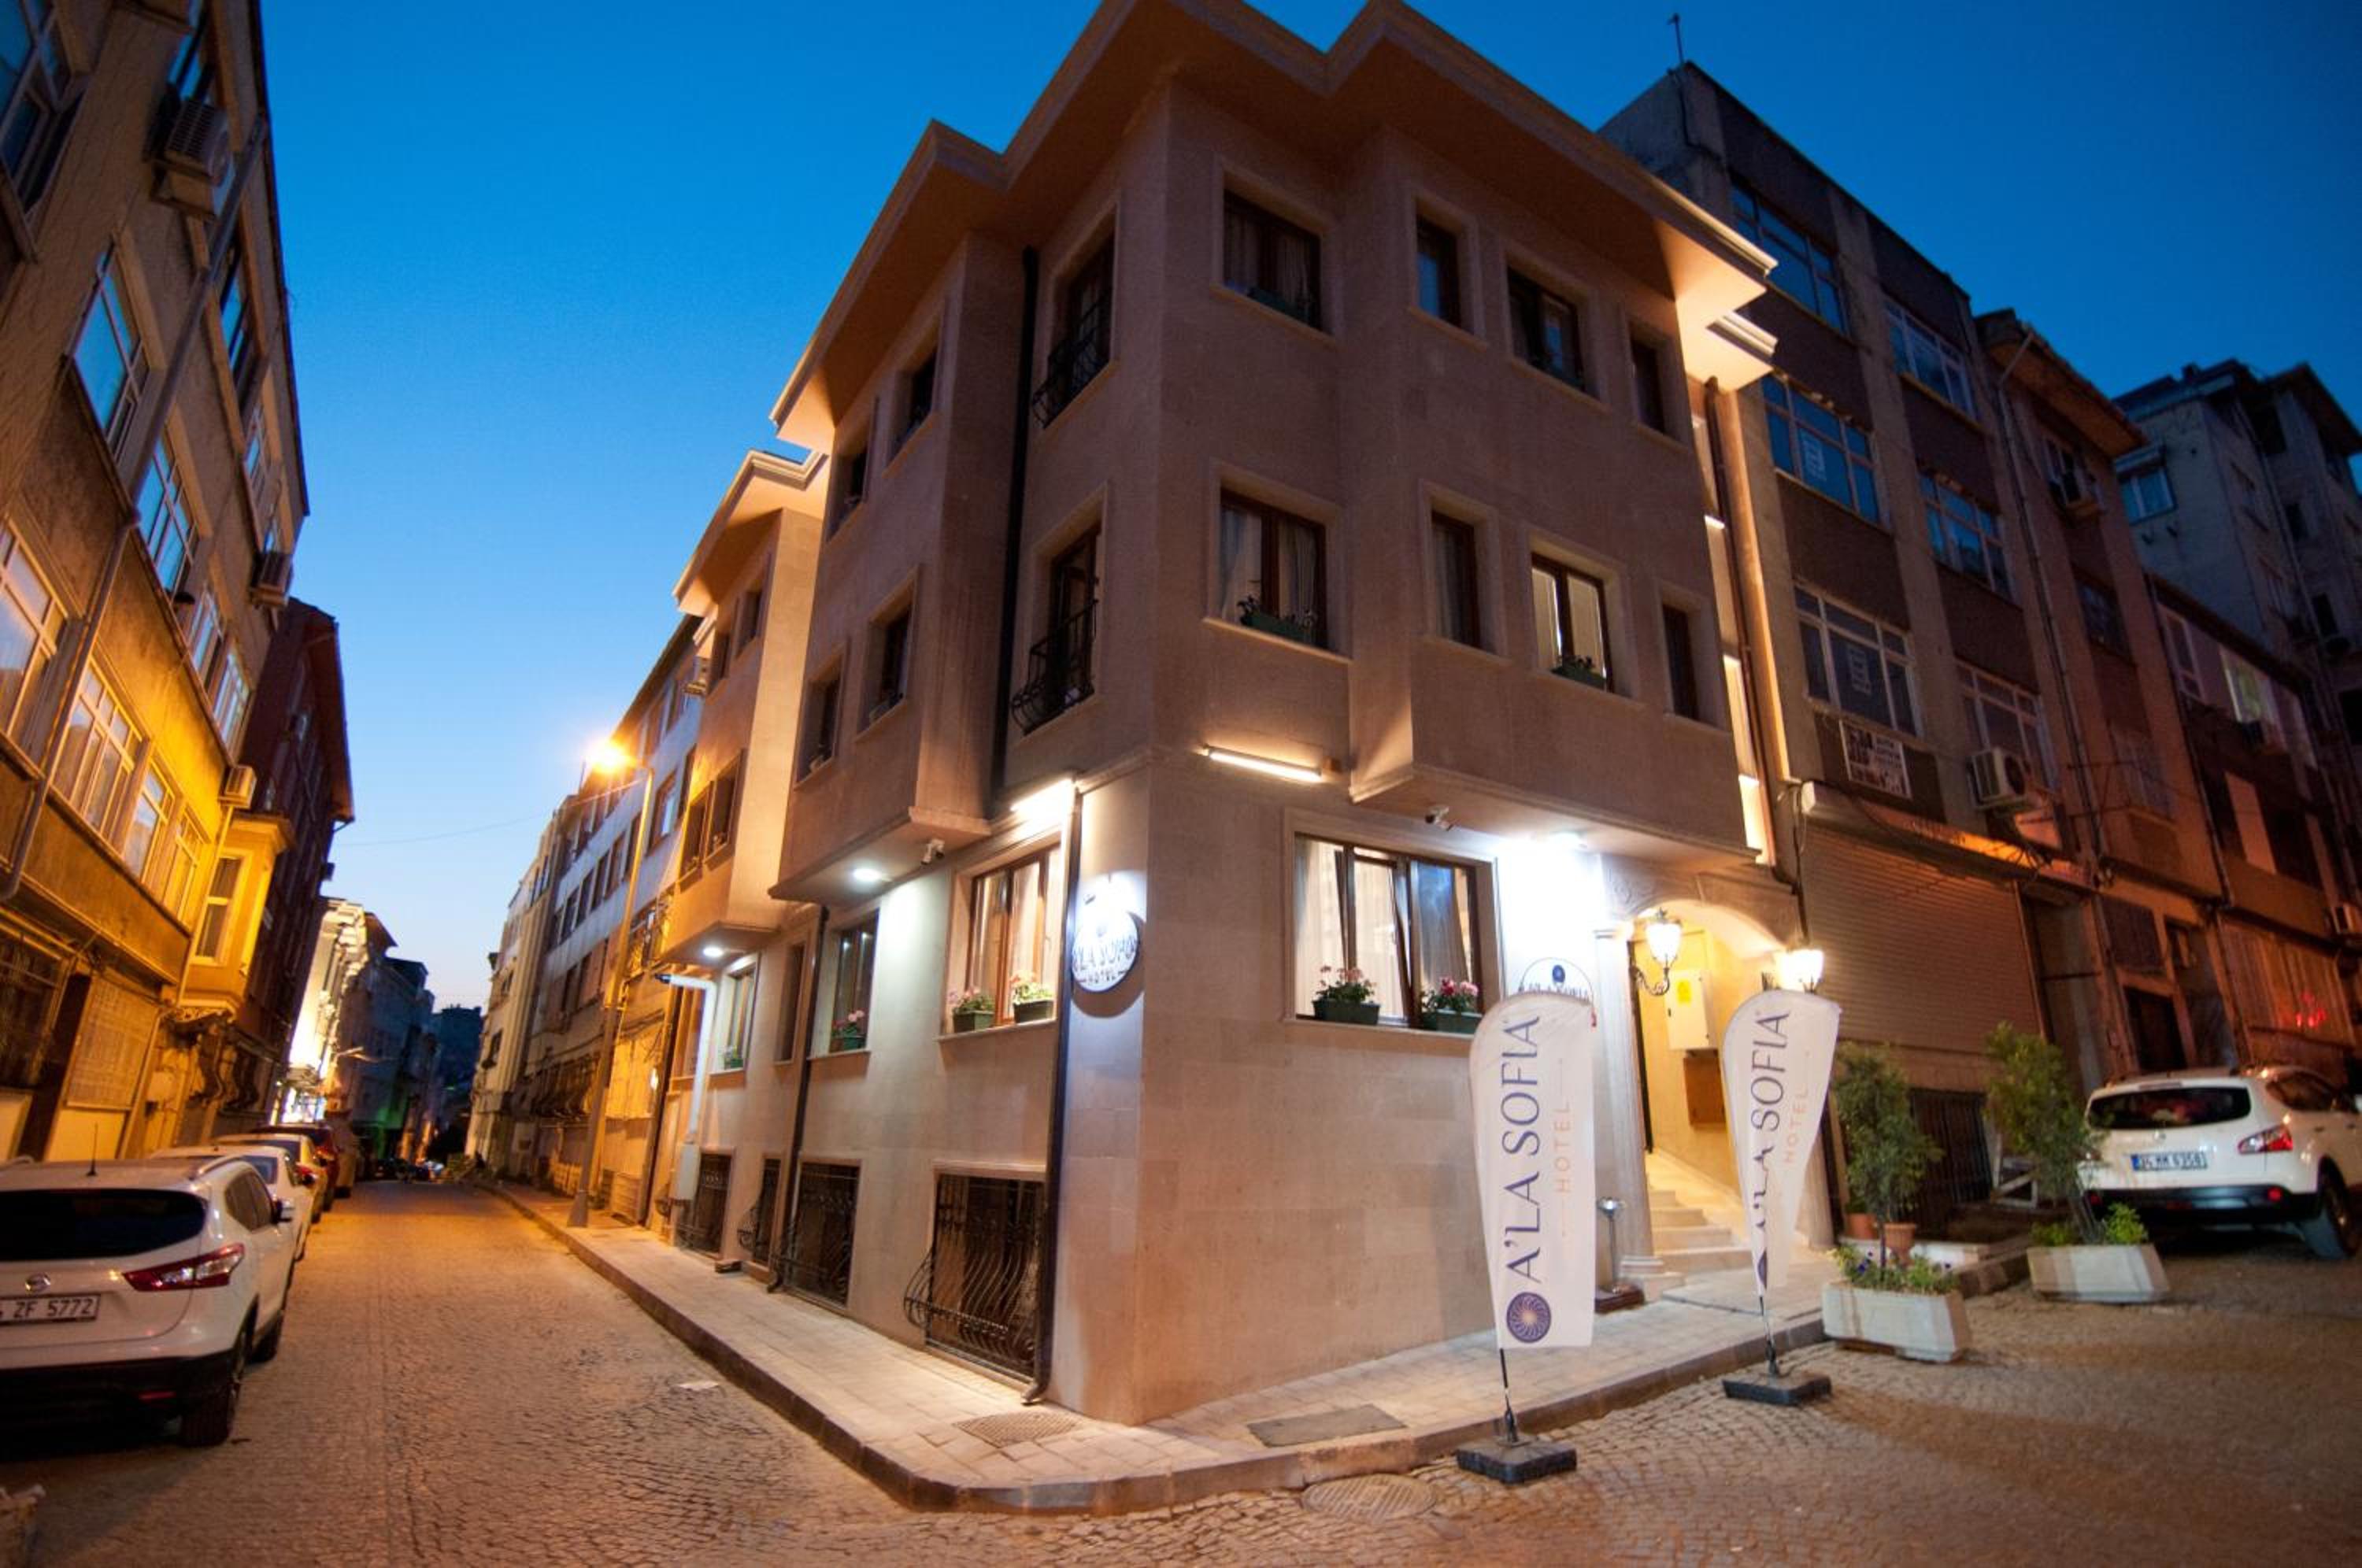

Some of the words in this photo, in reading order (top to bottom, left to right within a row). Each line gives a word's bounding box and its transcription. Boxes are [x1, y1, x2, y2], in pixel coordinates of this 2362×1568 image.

[1500, 1015, 1541, 1156] SOFIA
[1750, 1011, 1791, 1132] SOFIA
[1553, 1102, 1572, 1193] HOTEL
[1783, 1084, 1809, 1164] HOTEL
[1503, 1170, 1542, 1285] A'LA
[13, 1300, 38, 1319] ZF
[47, 1297, 94, 1318] 5772
